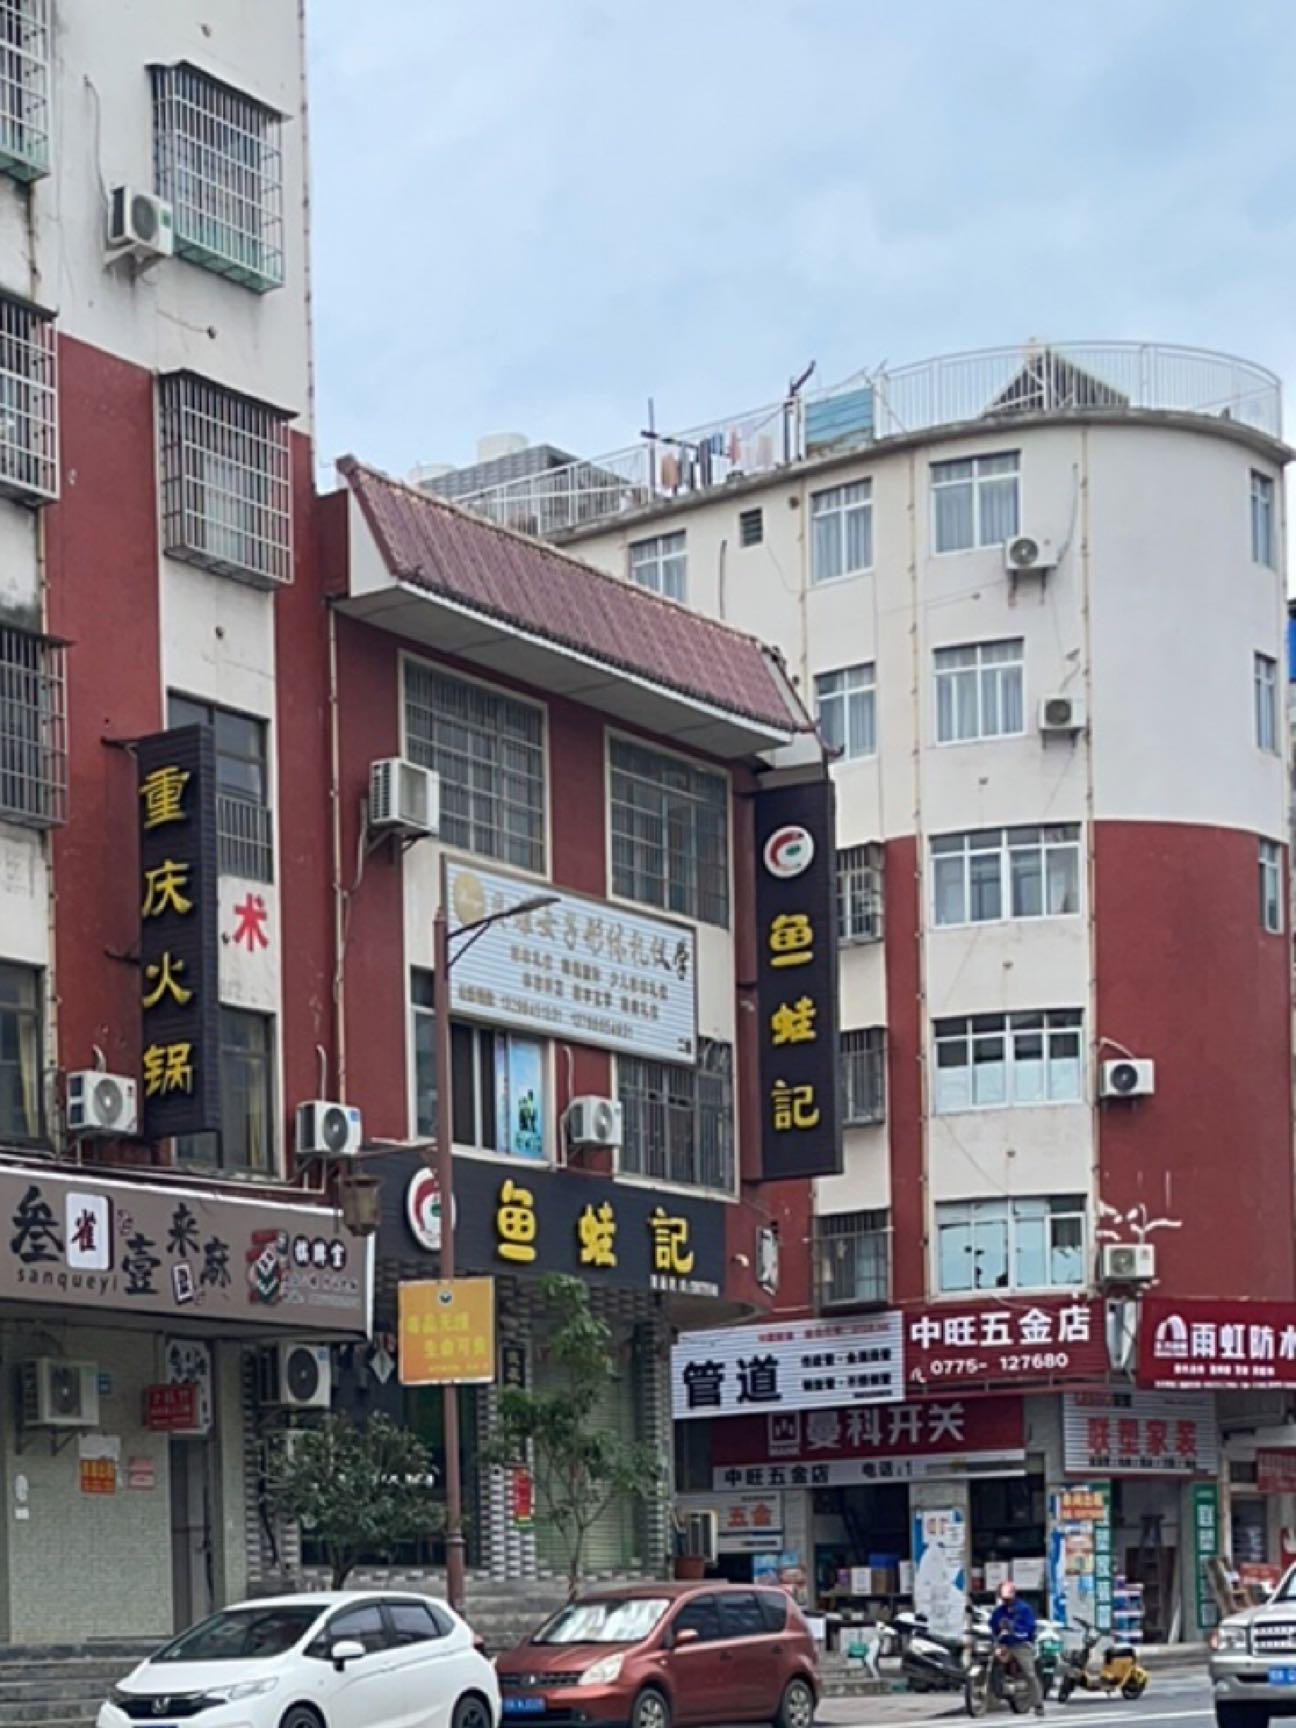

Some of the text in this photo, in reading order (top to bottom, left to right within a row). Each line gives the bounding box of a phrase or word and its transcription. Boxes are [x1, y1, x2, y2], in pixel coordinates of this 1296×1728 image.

[139, 766, 193, 1097] 重庆火锅
[233, 892, 268, 951] 术
[16, 1267, 118, 1295] sanqueyi
[911, 1305, 1090, 1349] 中旺五金店
[683, 1352, 783, 1408] 管道
[806, 1402, 965, 1449] 曼科开关
[724, 1464, 829, 1487] 中旺五金店
[727, 1502, 772, 1527] 五金
